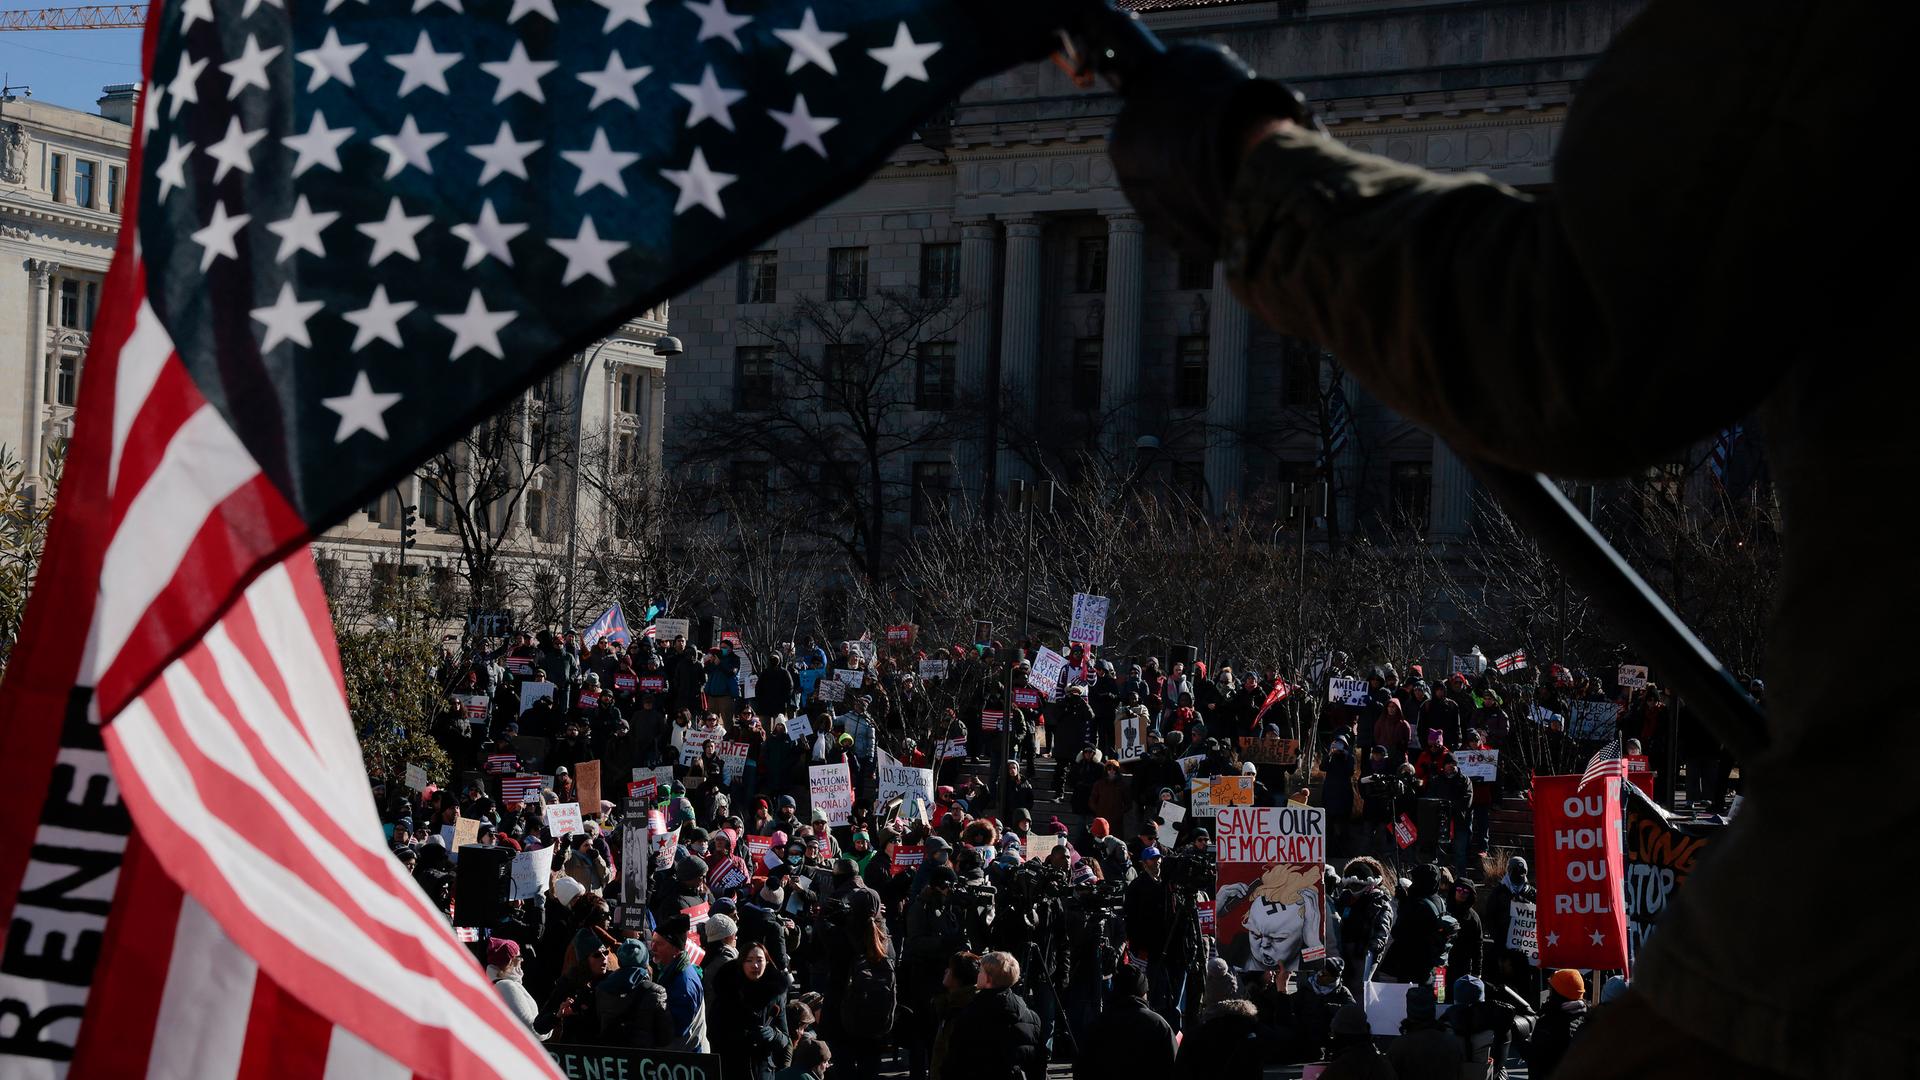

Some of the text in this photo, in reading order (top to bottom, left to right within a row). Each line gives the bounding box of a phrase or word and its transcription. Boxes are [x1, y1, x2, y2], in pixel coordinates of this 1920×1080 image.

[1072, 626, 1101, 643] BUSSY
[1332, 680, 1367, 692] AMERICA
[720, 741, 747, 757] HATE
[1121, 745, 1142, 759] ICE
[821, 768, 839, 776] THE
[811, 775, 849, 787] NATIONAL
[812, 784, 850, 794] EMERGENCY
[815, 798, 848, 810] DONALD
[1563, 796, 1604, 818] OU
[1217, 808, 1322, 836] SAVE OUR
[1217, 835, 1322, 862] DEMOCRACY!
[895, 858, 913, 866] FREE
[1566, 860, 1607, 882] OU
[1555, 893, 1610, 914] RUL
[1514, 919, 1536, 928] NEUT
[1511, 938, 1538, 948] CHOSE
[640, 1058, 706, 1080] GOOD
